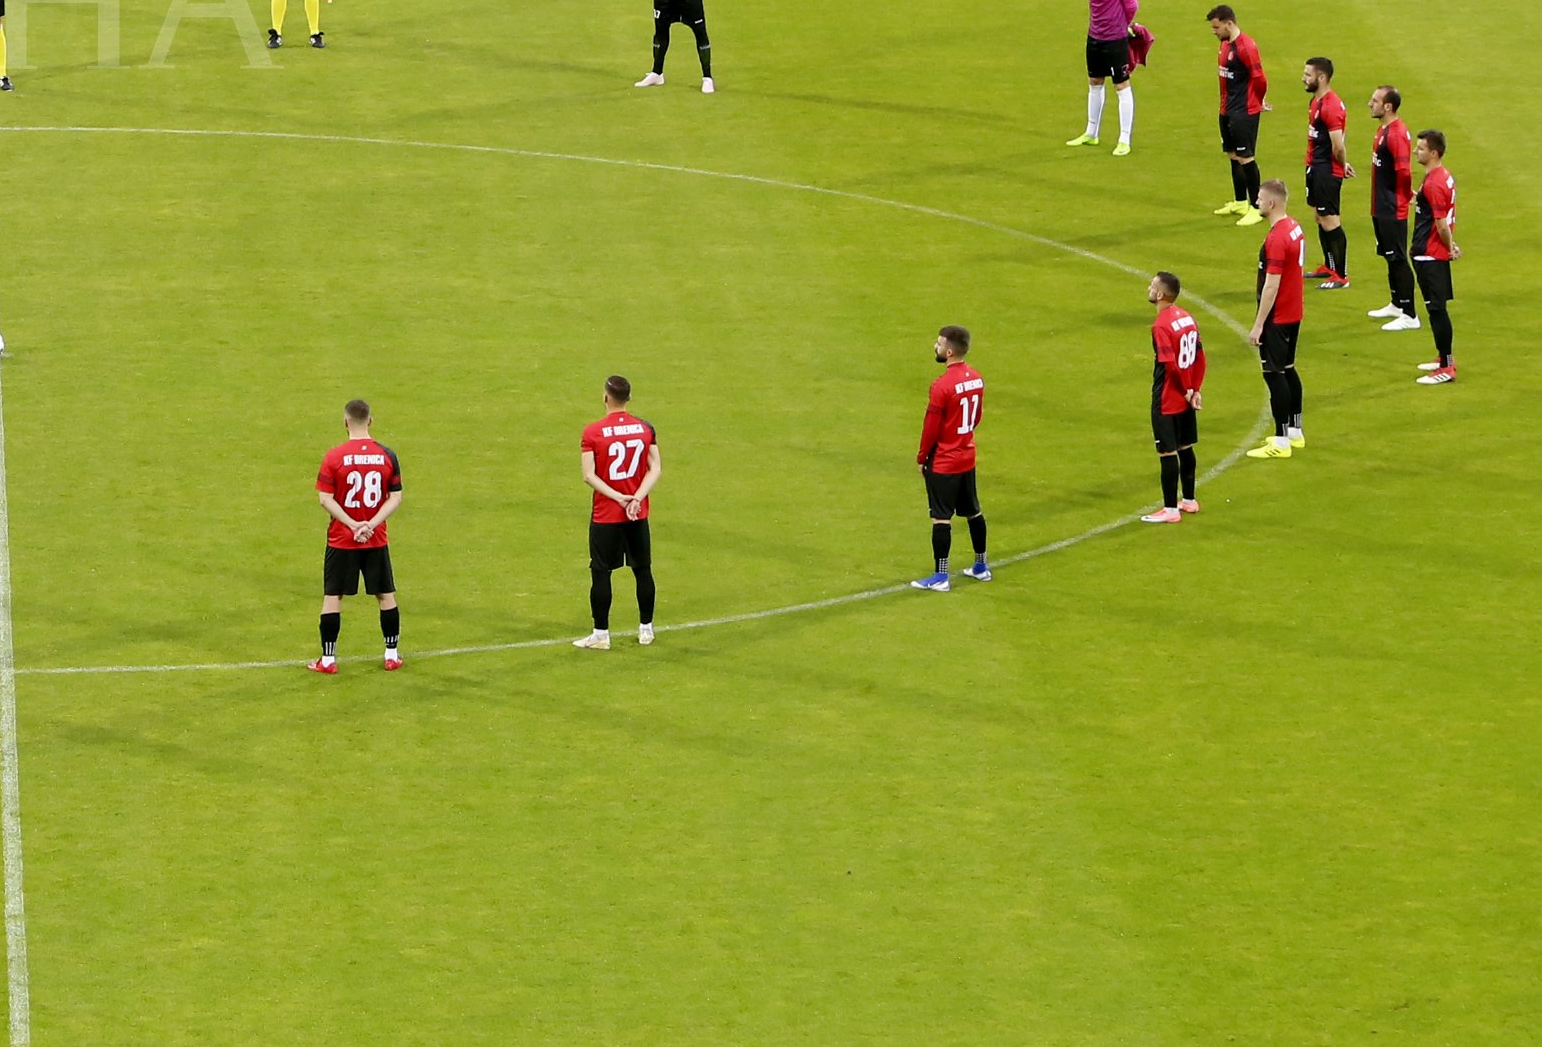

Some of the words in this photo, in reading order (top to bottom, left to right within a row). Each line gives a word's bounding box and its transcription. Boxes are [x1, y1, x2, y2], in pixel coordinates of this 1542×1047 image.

[1177, 331, 1198, 370] 88
[601, 426, 613, 438] KF
[343, 454, 354, 466] KF
[608, 438, 645, 481] 27
[344, 470, 383, 509] 28
